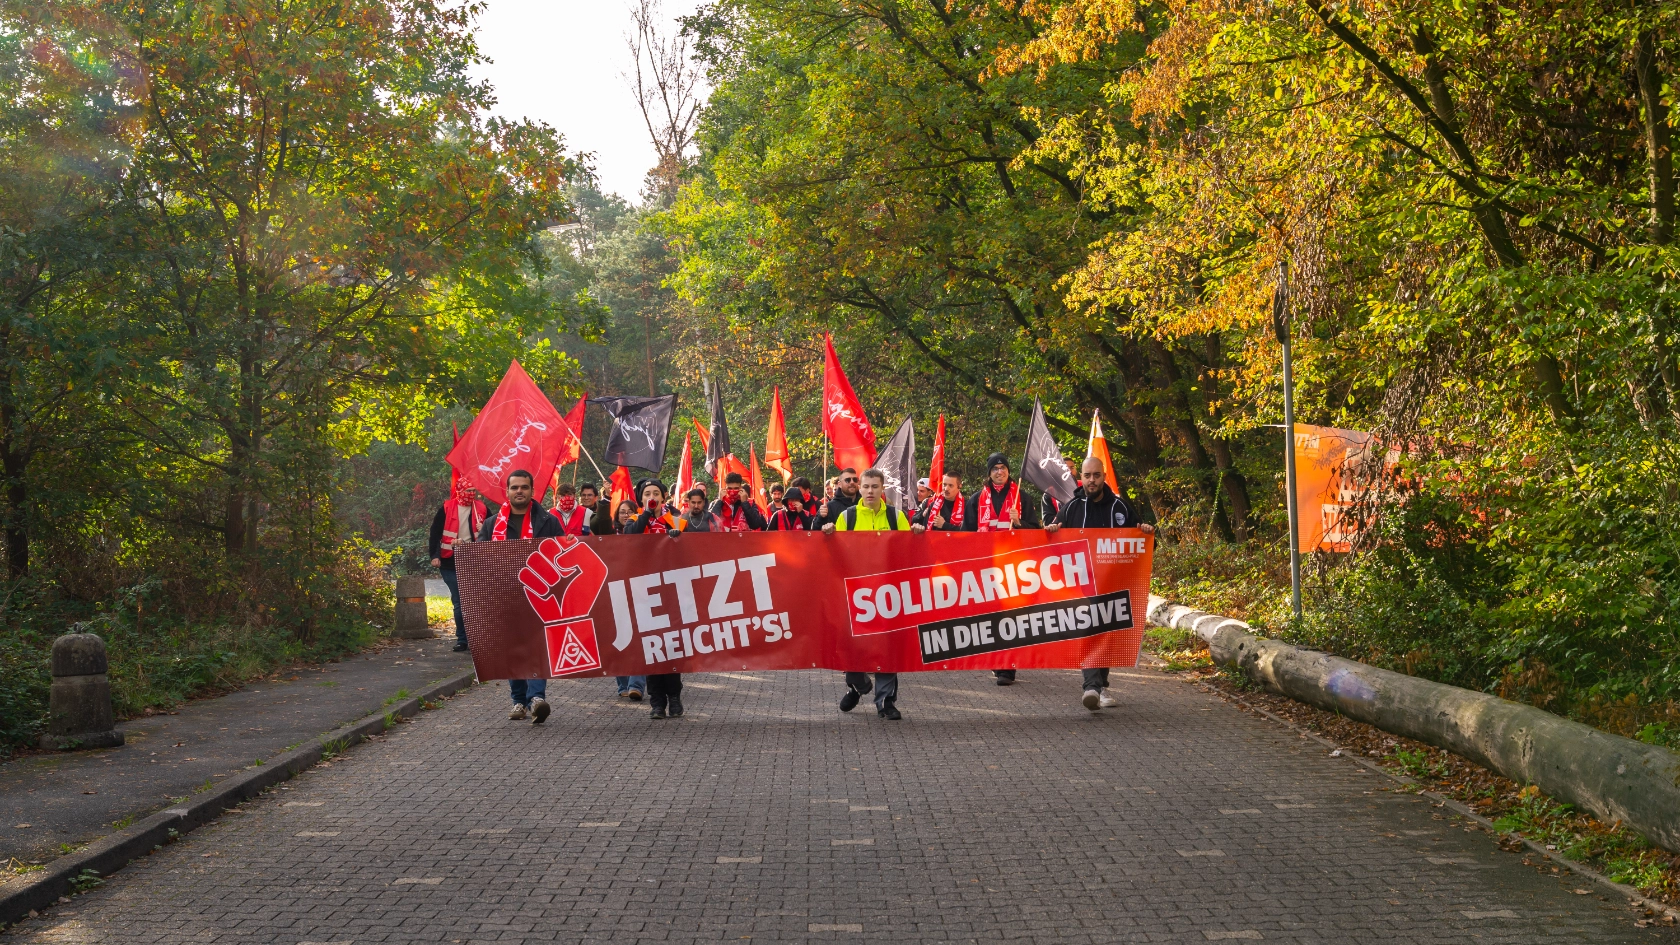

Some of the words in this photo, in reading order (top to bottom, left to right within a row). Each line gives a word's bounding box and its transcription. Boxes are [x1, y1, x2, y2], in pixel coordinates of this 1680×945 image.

[608, 553, 776, 651] JETZT
[852, 551, 1090, 623] SOLIDARISCH
[641, 611, 793, 665] REICHT'S!
[922, 628, 949, 655] IN
[953, 620, 995, 650] DIE
[999, 597, 1130, 641] OFFENSIVE
